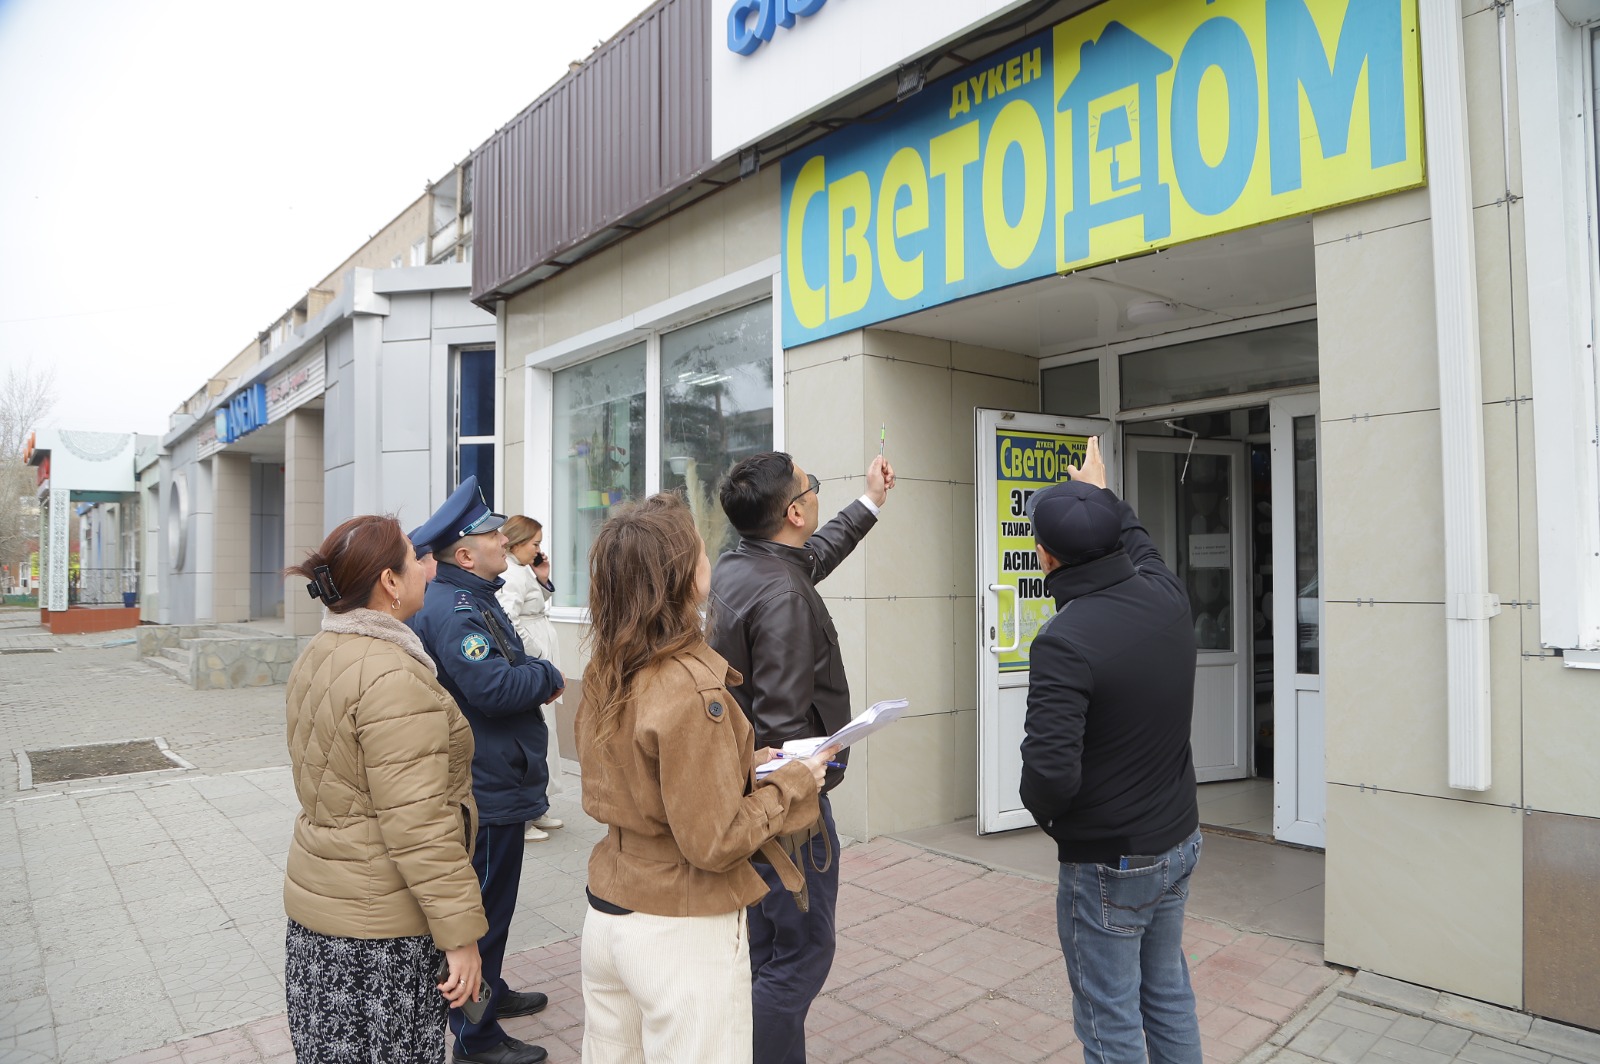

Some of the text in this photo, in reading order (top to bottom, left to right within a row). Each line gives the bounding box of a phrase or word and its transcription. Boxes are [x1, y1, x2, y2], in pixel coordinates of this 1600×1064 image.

[1001, 522, 1034, 536] ТАУАР
[1004, 551, 1042, 570] АСПА
[1019, 578, 1052, 598] ЛЮС
